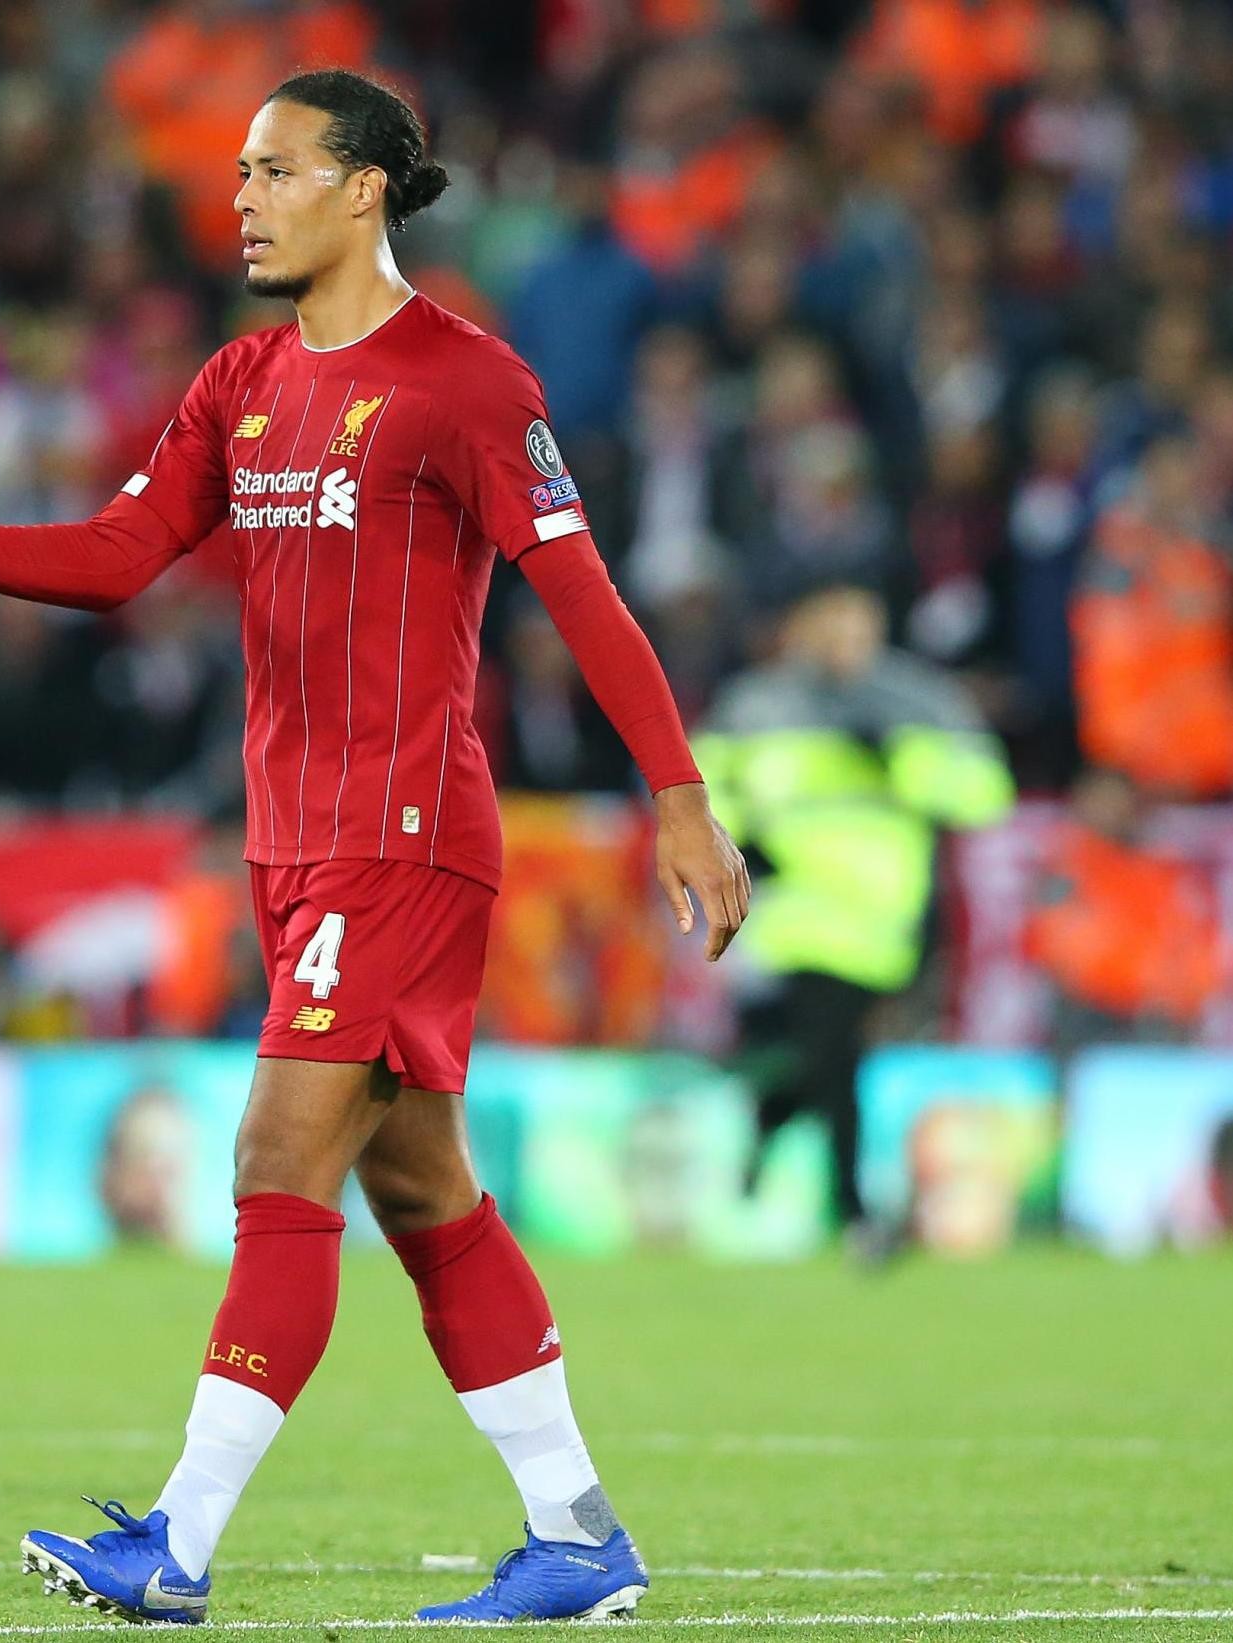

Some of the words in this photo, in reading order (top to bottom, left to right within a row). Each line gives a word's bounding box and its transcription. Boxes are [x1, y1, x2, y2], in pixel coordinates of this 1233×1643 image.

[546, 447, 555, 463] 6
[233, 466, 320, 495] Standard
[230, 500, 313, 529] Chartered
[294, 912, 345, 999] 4
